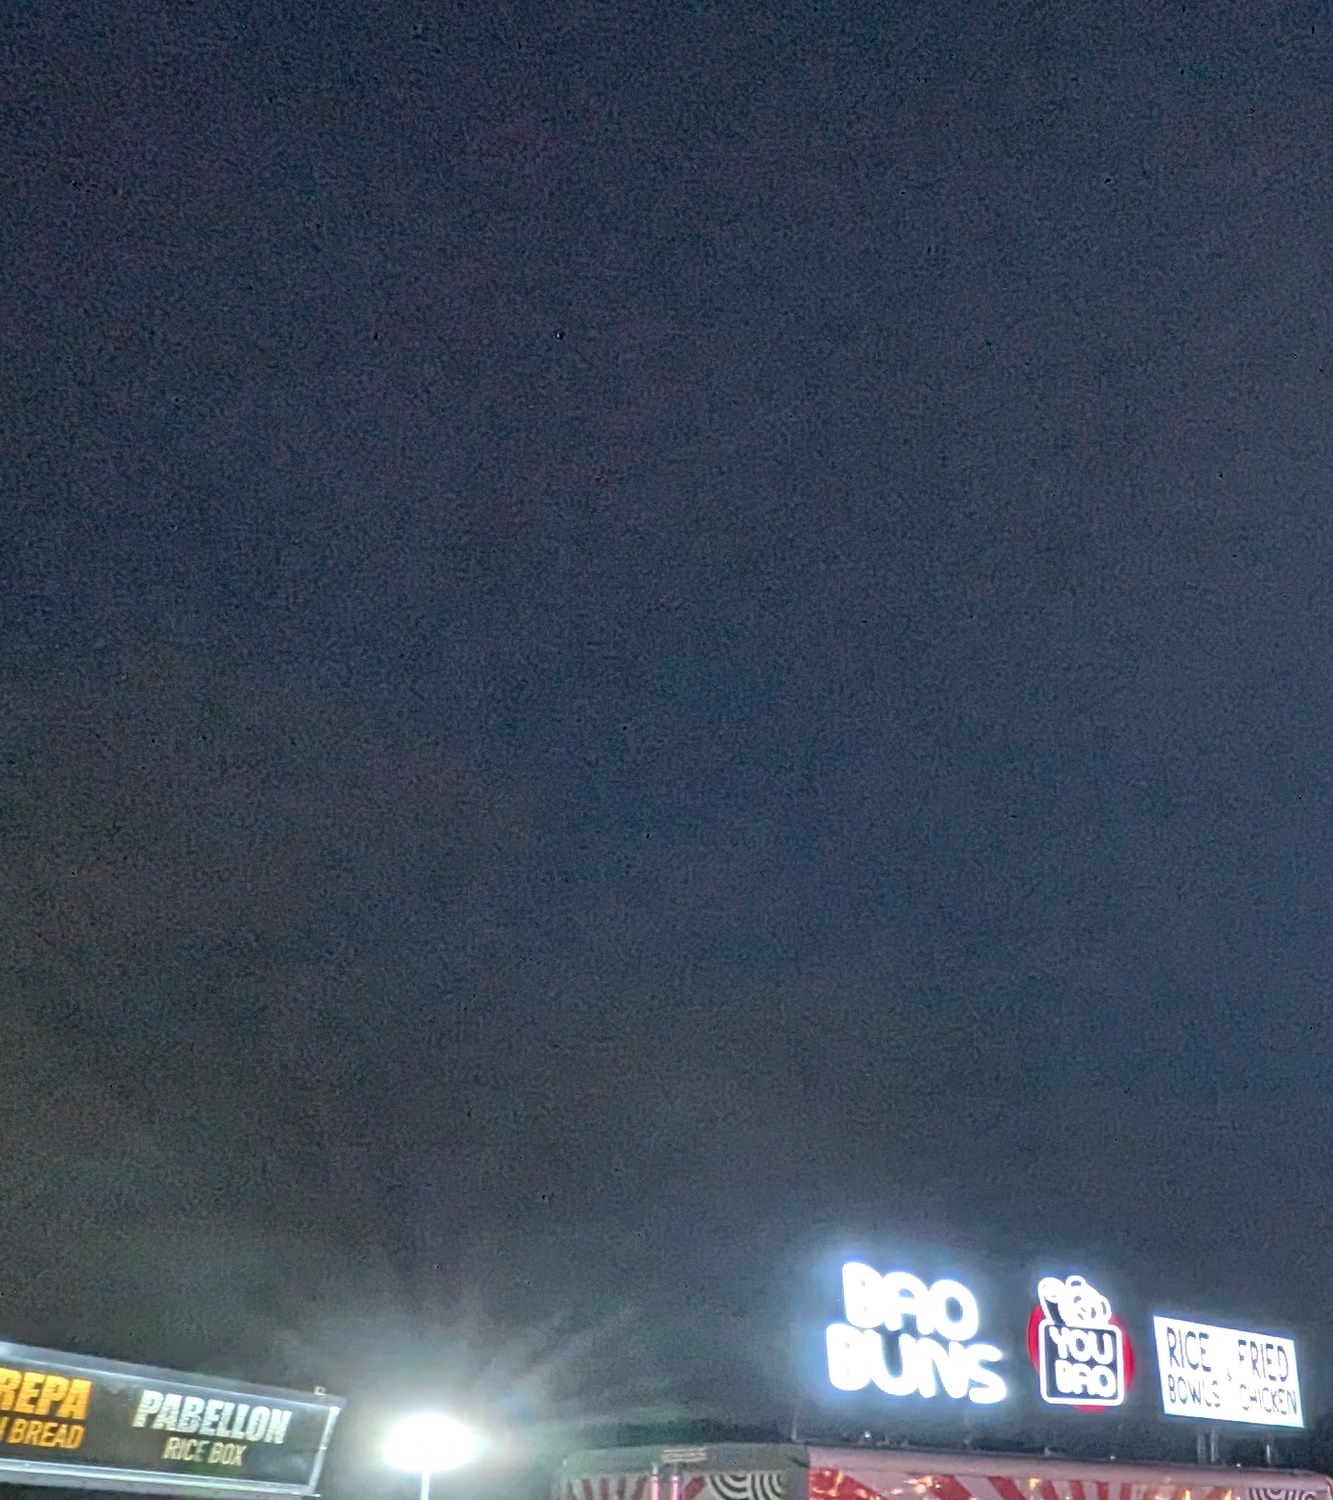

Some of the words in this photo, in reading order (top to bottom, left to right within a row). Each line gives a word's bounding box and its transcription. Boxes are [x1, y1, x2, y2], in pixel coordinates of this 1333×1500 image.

[841, 1261, 979, 1341] BAO
[825, 1323, 1006, 1404] BUNS
[1048, 1325, 1114, 1364] YOU
[1166, 1326, 1212, 1372] RICE
[1237, 1339, 1289, 1382] FRIED
[1054, 1359, 1117, 1397] BAO
[1167, 1373, 1221, 1408] BOWLS
[1239, 1383, 1297, 1415] CHICKEN
[7, 1417, 85, 1450] BREAD
[132, 1390, 292, 1444] PABELLON
[162, 1436, 210, 1463] RICE
[207, 1441, 246, 1467] BOX
